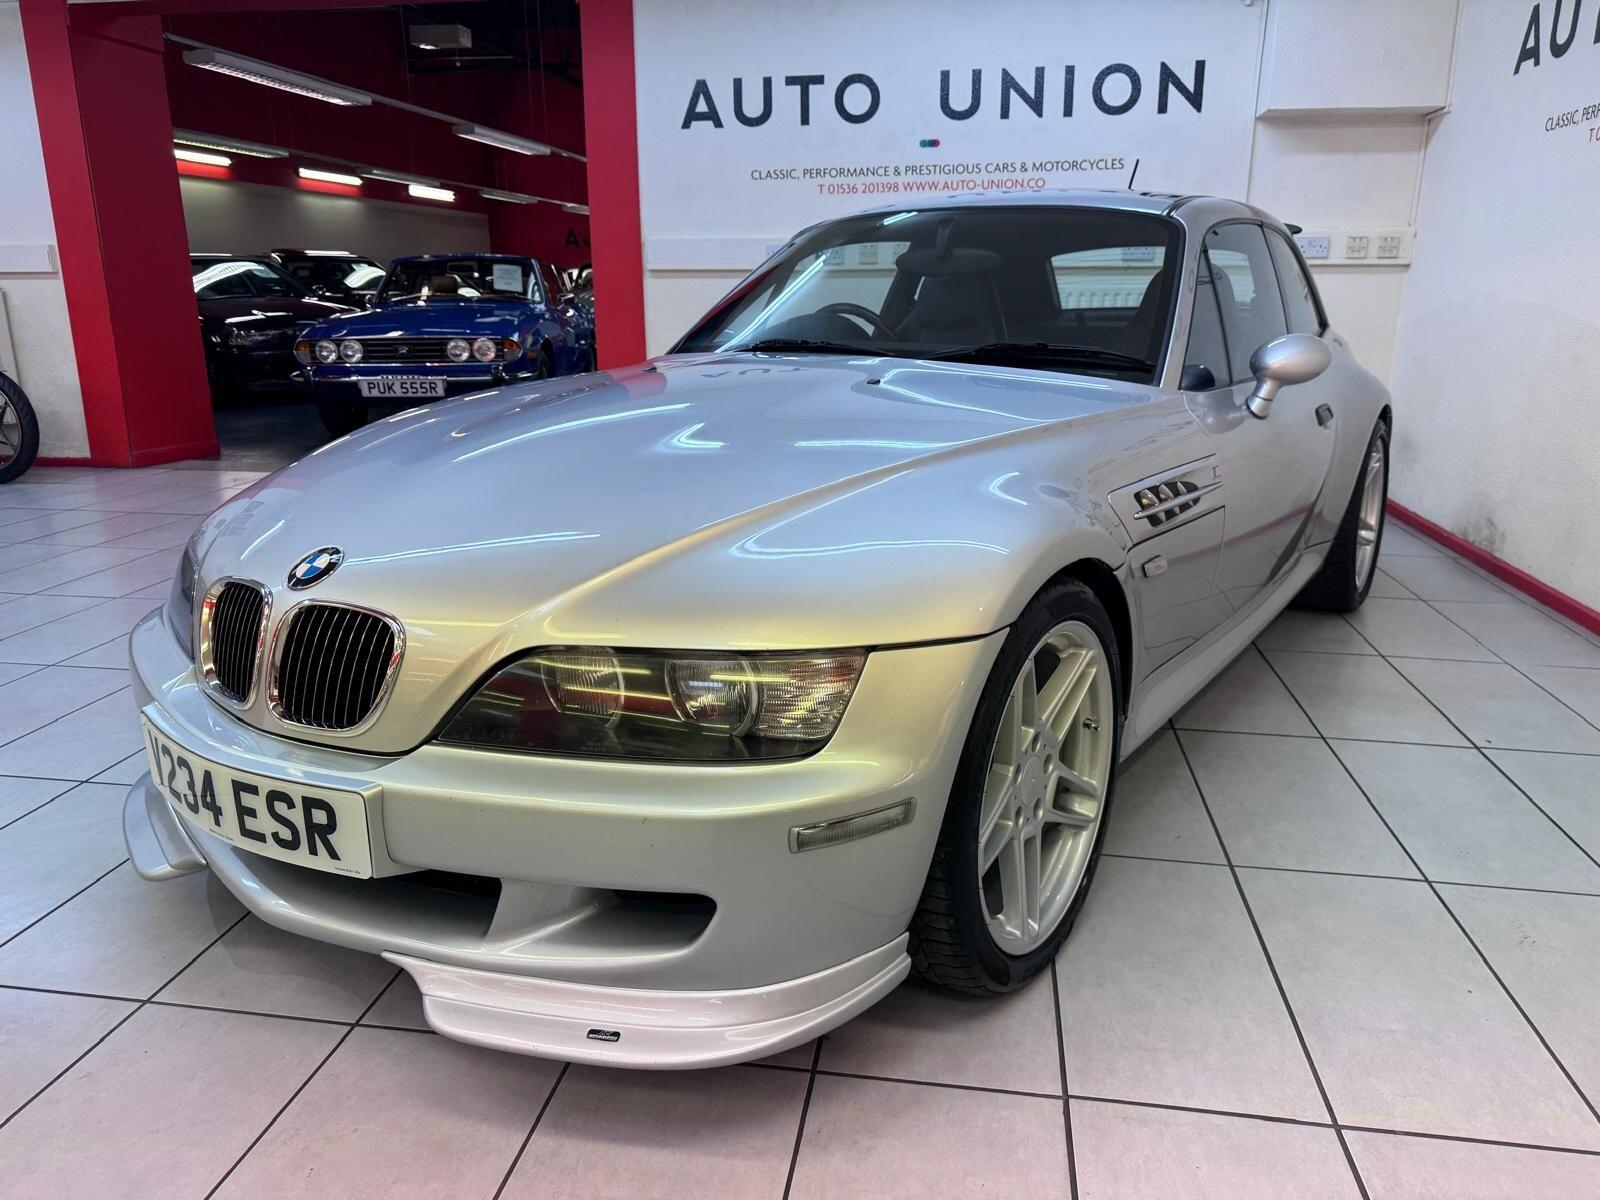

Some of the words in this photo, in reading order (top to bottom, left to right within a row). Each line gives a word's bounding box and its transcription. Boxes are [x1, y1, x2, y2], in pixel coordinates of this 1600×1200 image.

[1513, 0, 1600, 75] AU
[681, 73, 881, 130] AUTO
[940, 59, 1207, 121] UNION
[1545, 109, 1579, 132] CLASSIC,
[751, 168, 800, 181] CLASSIC,
[803, 165, 890, 179] PERFORMANCE
[893, 165, 901, 177] &
[904, 162, 982, 177] PRESTIGIOUS
[984, 161, 1017, 174] CARS
[1020, 161, 1029, 173] &
[1032, 157, 1125, 173] MOTORCYCLES
[818, 183, 826, 194] T
[828, 182, 858, 195] 01536
[862, 182, 899, 193] 201398
[902, 177, 1046, 192] WWW.AUTO-UNION.CO
[367, 381, 396, 395] PUK
[400, 381, 438, 395] 555R
[231, 778, 342, 862] ESR
